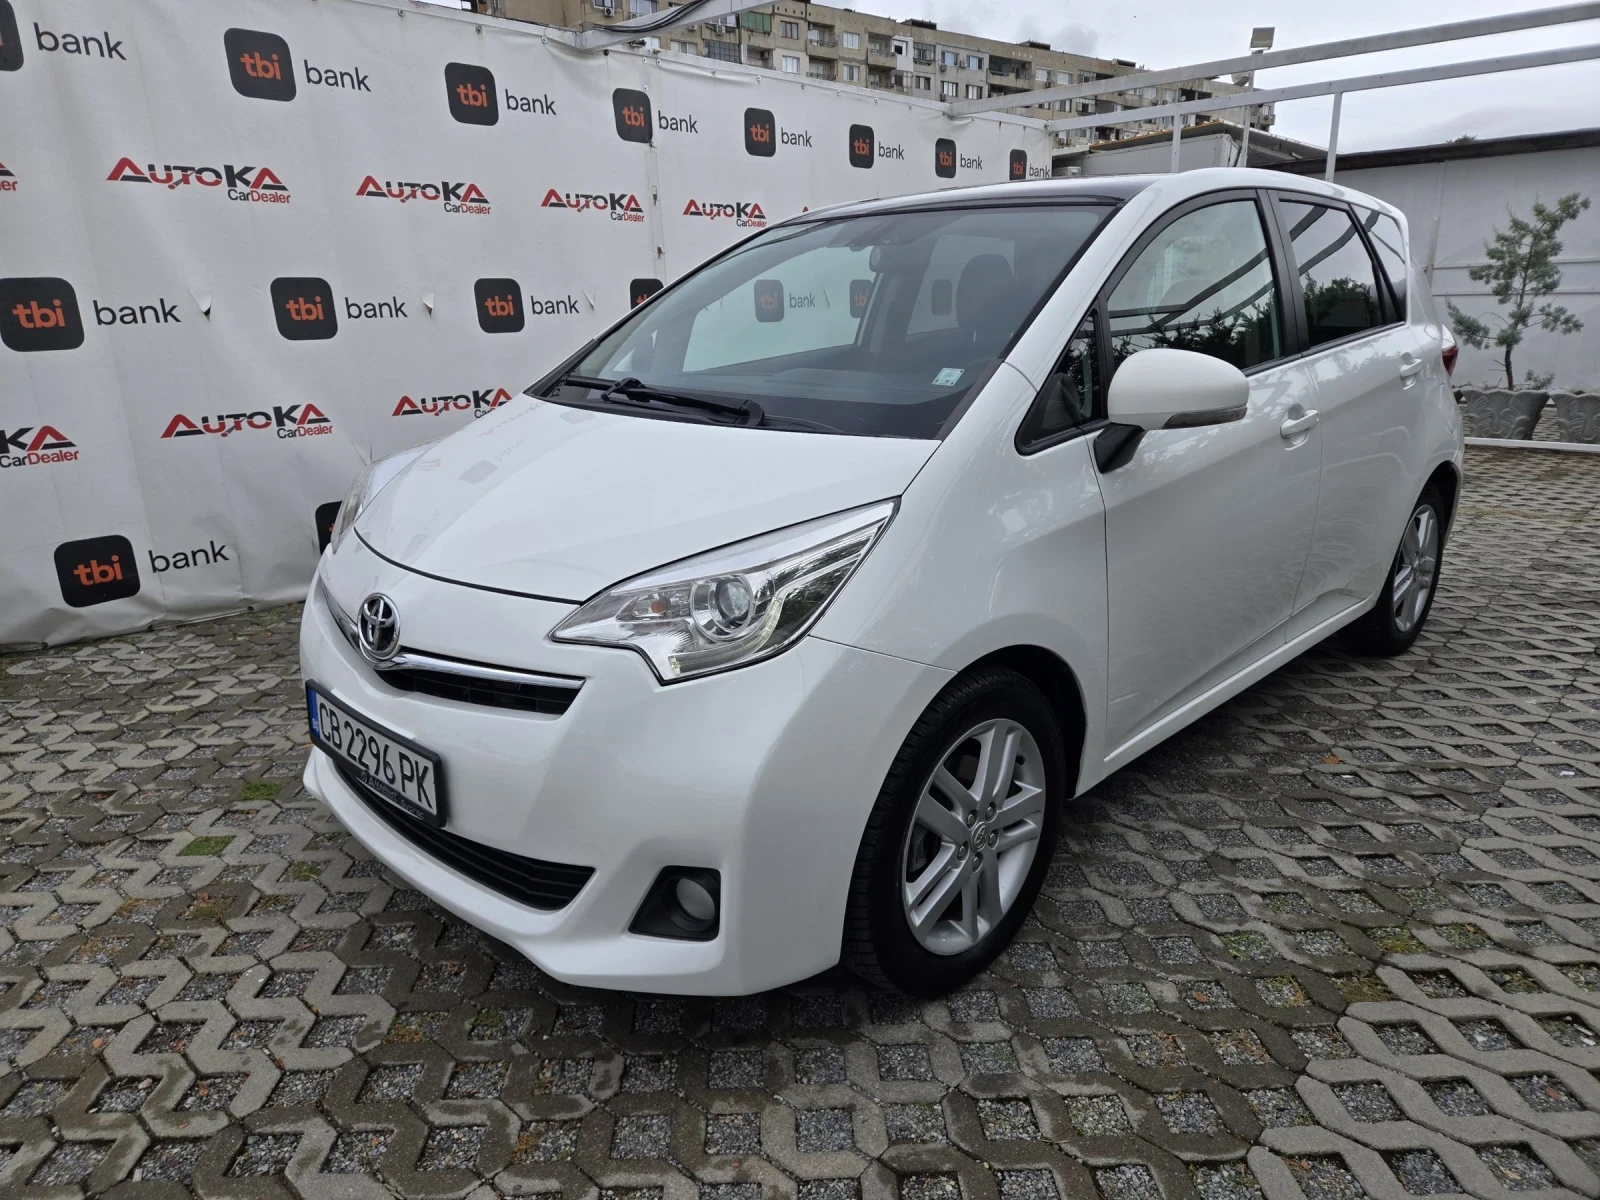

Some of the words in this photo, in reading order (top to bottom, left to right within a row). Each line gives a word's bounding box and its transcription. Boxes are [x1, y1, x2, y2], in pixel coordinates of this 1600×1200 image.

[33, 22, 127, 61] bank
[240, 53, 281, 80] tbi
[304, 60, 371, 92] bank
[456, 83, 488, 108] tbi
[505, 89, 557, 116] bank
[622, 105, 645, 127] tbi
[658, 111, 698, 134] bank
[750, 124, 770, 143] tbi
[780, 127, 813, 148] bank
[853, 138, 870, 156] tbi
[878, 141, 905, 160] bank
[939, 151, 953, 167] tbi
[960, 153, 983, 170] bank
[1012, 161, 1024, 175] tbi
[1028, 163, 1051, 178] bank
[227, 188, 291, 204] CarDealer
[443, 201, 491, 215] CarDealer
[610, 211, 645, 223] CarDealer
[736, 218, 767, 229] CarDealer
[285, 296, 325, 321] tbi
[345, 296, 408, 319] bank
[484, 294, 515, 316] tbi
[530, 294, 580, 315] bank
[760, 292, 778, 308] tbi
[789, 291, 816, 308] bank
[12, 299, 66, 329] tbi
[92, 298, 182, 326] bank
[277, 424, 333, 439] CarDealer
[0, 450, 79, 468] CarDealer
[73, 555, 122, 586] tbi
[148, 540, 230, 574] bank
[319, 702, 342, 750] CB
[344, 720, 396, 785] 2296
[398, 751, 433, 809] PK
